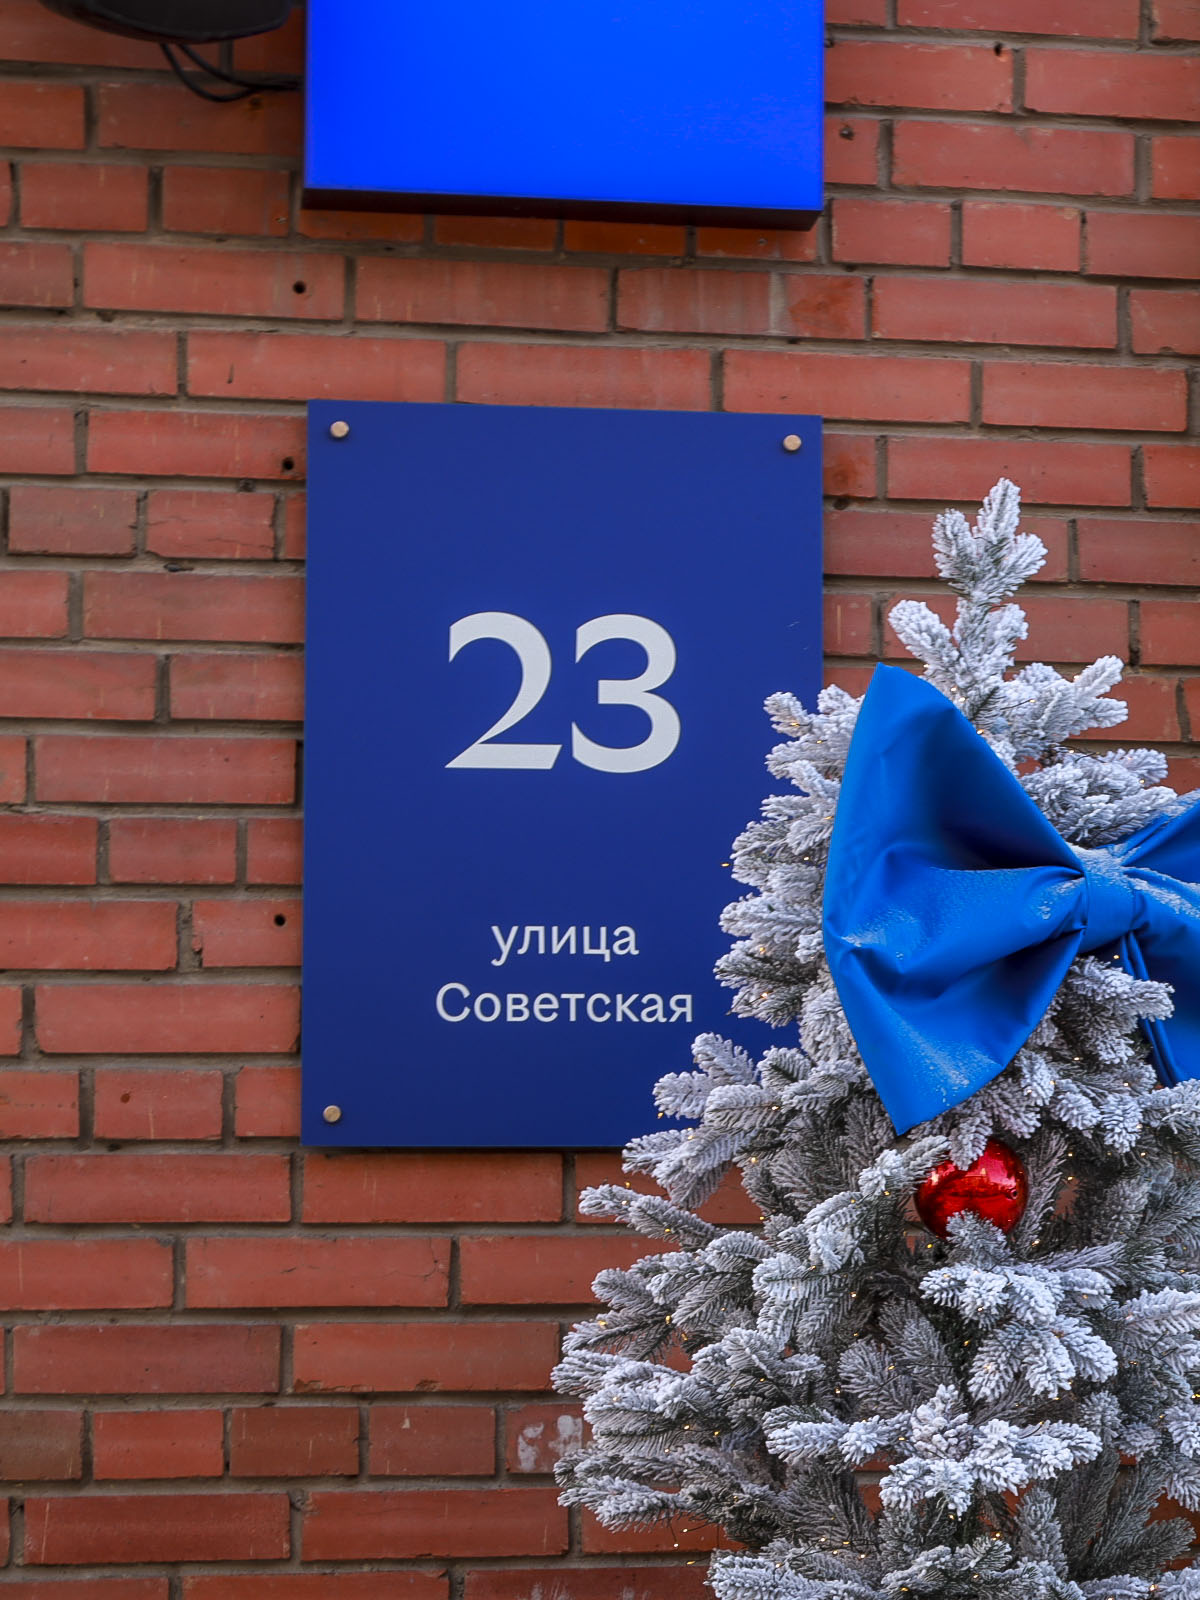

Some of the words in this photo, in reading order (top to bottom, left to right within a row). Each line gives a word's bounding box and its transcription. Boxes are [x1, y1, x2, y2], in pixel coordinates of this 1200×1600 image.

[444, 611, 682, 773] 23
[491, 924, 640, 966] улица
[435, 982, 693, 1023] Советская
